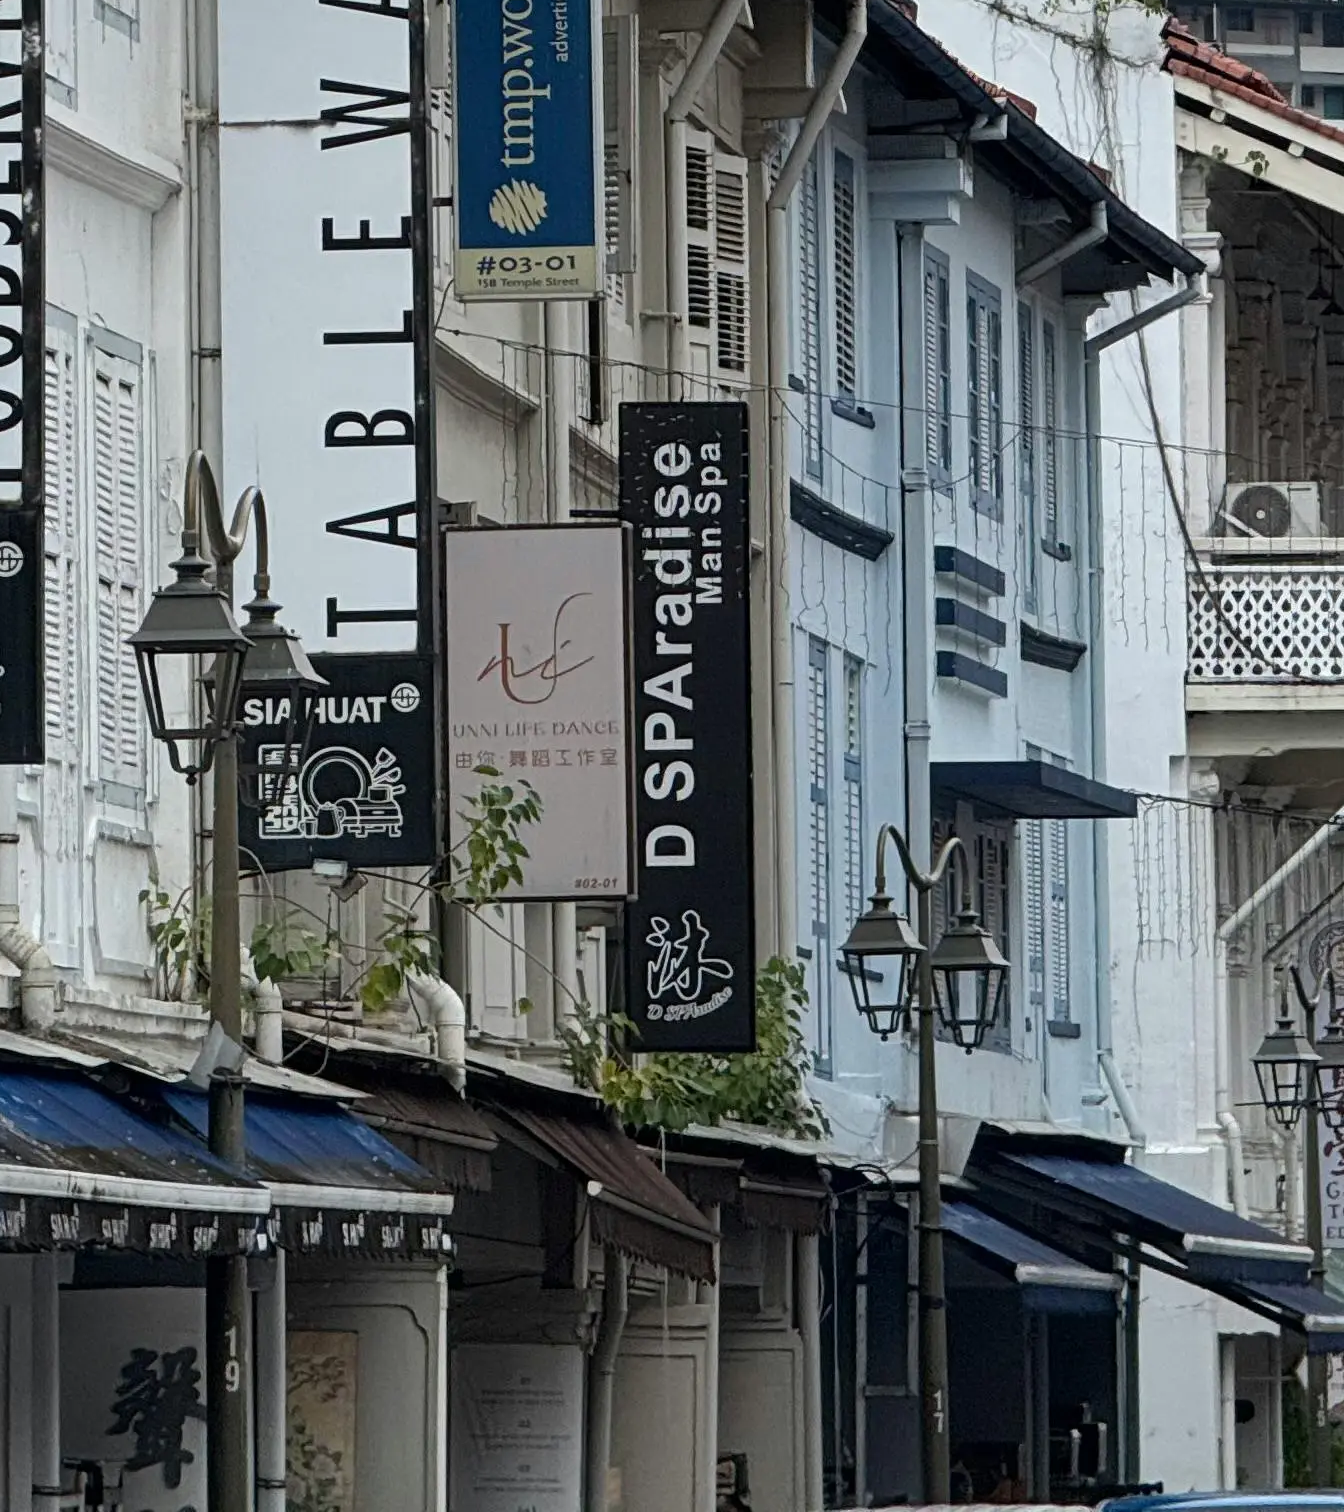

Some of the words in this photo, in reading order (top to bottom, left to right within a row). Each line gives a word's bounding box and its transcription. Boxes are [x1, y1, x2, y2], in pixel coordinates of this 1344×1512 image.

[477, 255, 576, 276] #03-01
[501, 278, 542, 290] Temple
[545, 276, 580, 287] Street
[696, 442, 727, 515] Spa
[696, 527, 723, 606] Man
[642, 442, 695, 801] SPAradise
[453, 722, 498, 739] UNNI
[505, 721, 547, 738] LIFE
[552, 719, 620, 737] DANCE
[646, 823, 695, 867] D
